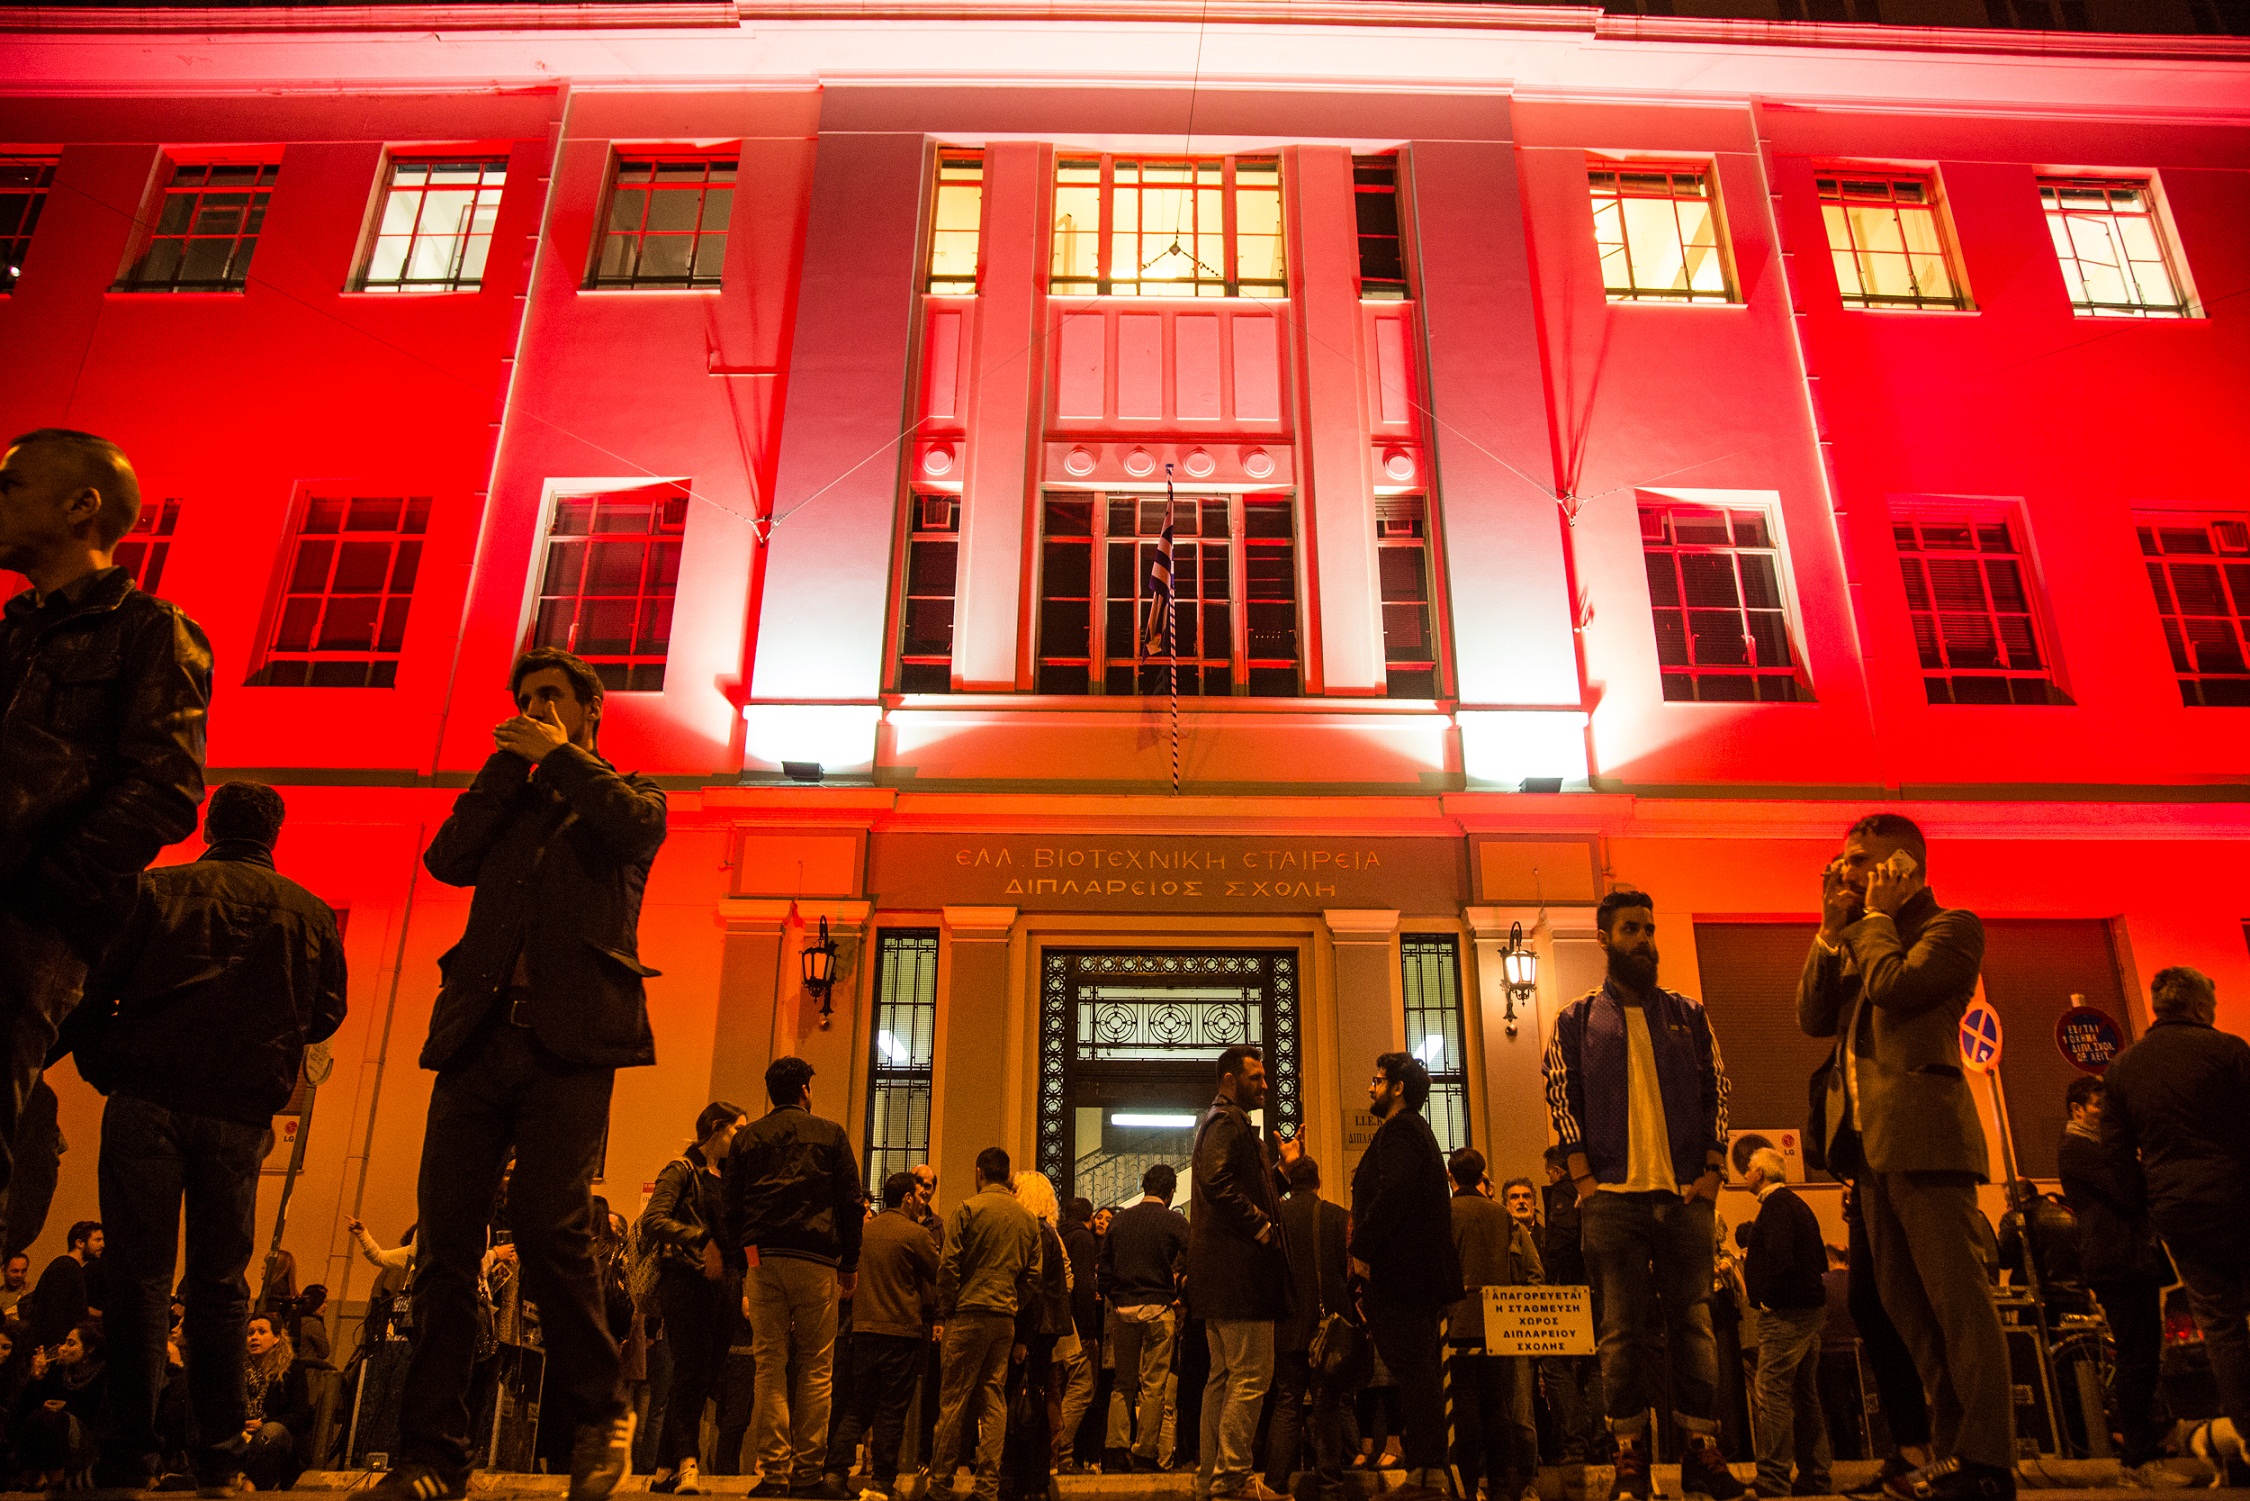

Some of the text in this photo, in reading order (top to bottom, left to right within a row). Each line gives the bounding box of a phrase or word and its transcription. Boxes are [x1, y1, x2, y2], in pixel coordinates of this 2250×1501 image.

[1035, 848, 1225, 870] ΒΙΟΤΕΧΝΙΚΗ
[1243, 850, 1380, 871] ΕΤΑΙΡΕΙΑ
[1005, 879, 1336, 897] ΔΙΠΛΑΡΕΙΟΣ ΣΧΟΛΗ
[283, 1135, 295, 1143] LG
[1348, 1133, 1375, 1144] ΔΙΠΛΑ
[1492, 1292, 1581, 1300] ΑΠΑΓΟΡΕΥΕΤΑΙ
[1495, 1305, 1581, 1313] Η ΣΤΑΘΜΕΥΣΗ
[1519, 1317, 1559, 1326] ΧΩΡΟΣ
[1503, 1330, 1576, 1338] ΔΙΠΛΑΡΕΙΟΥ
[1517, 1343, 1566, 1351] ΣΧΟΛΗΣ
